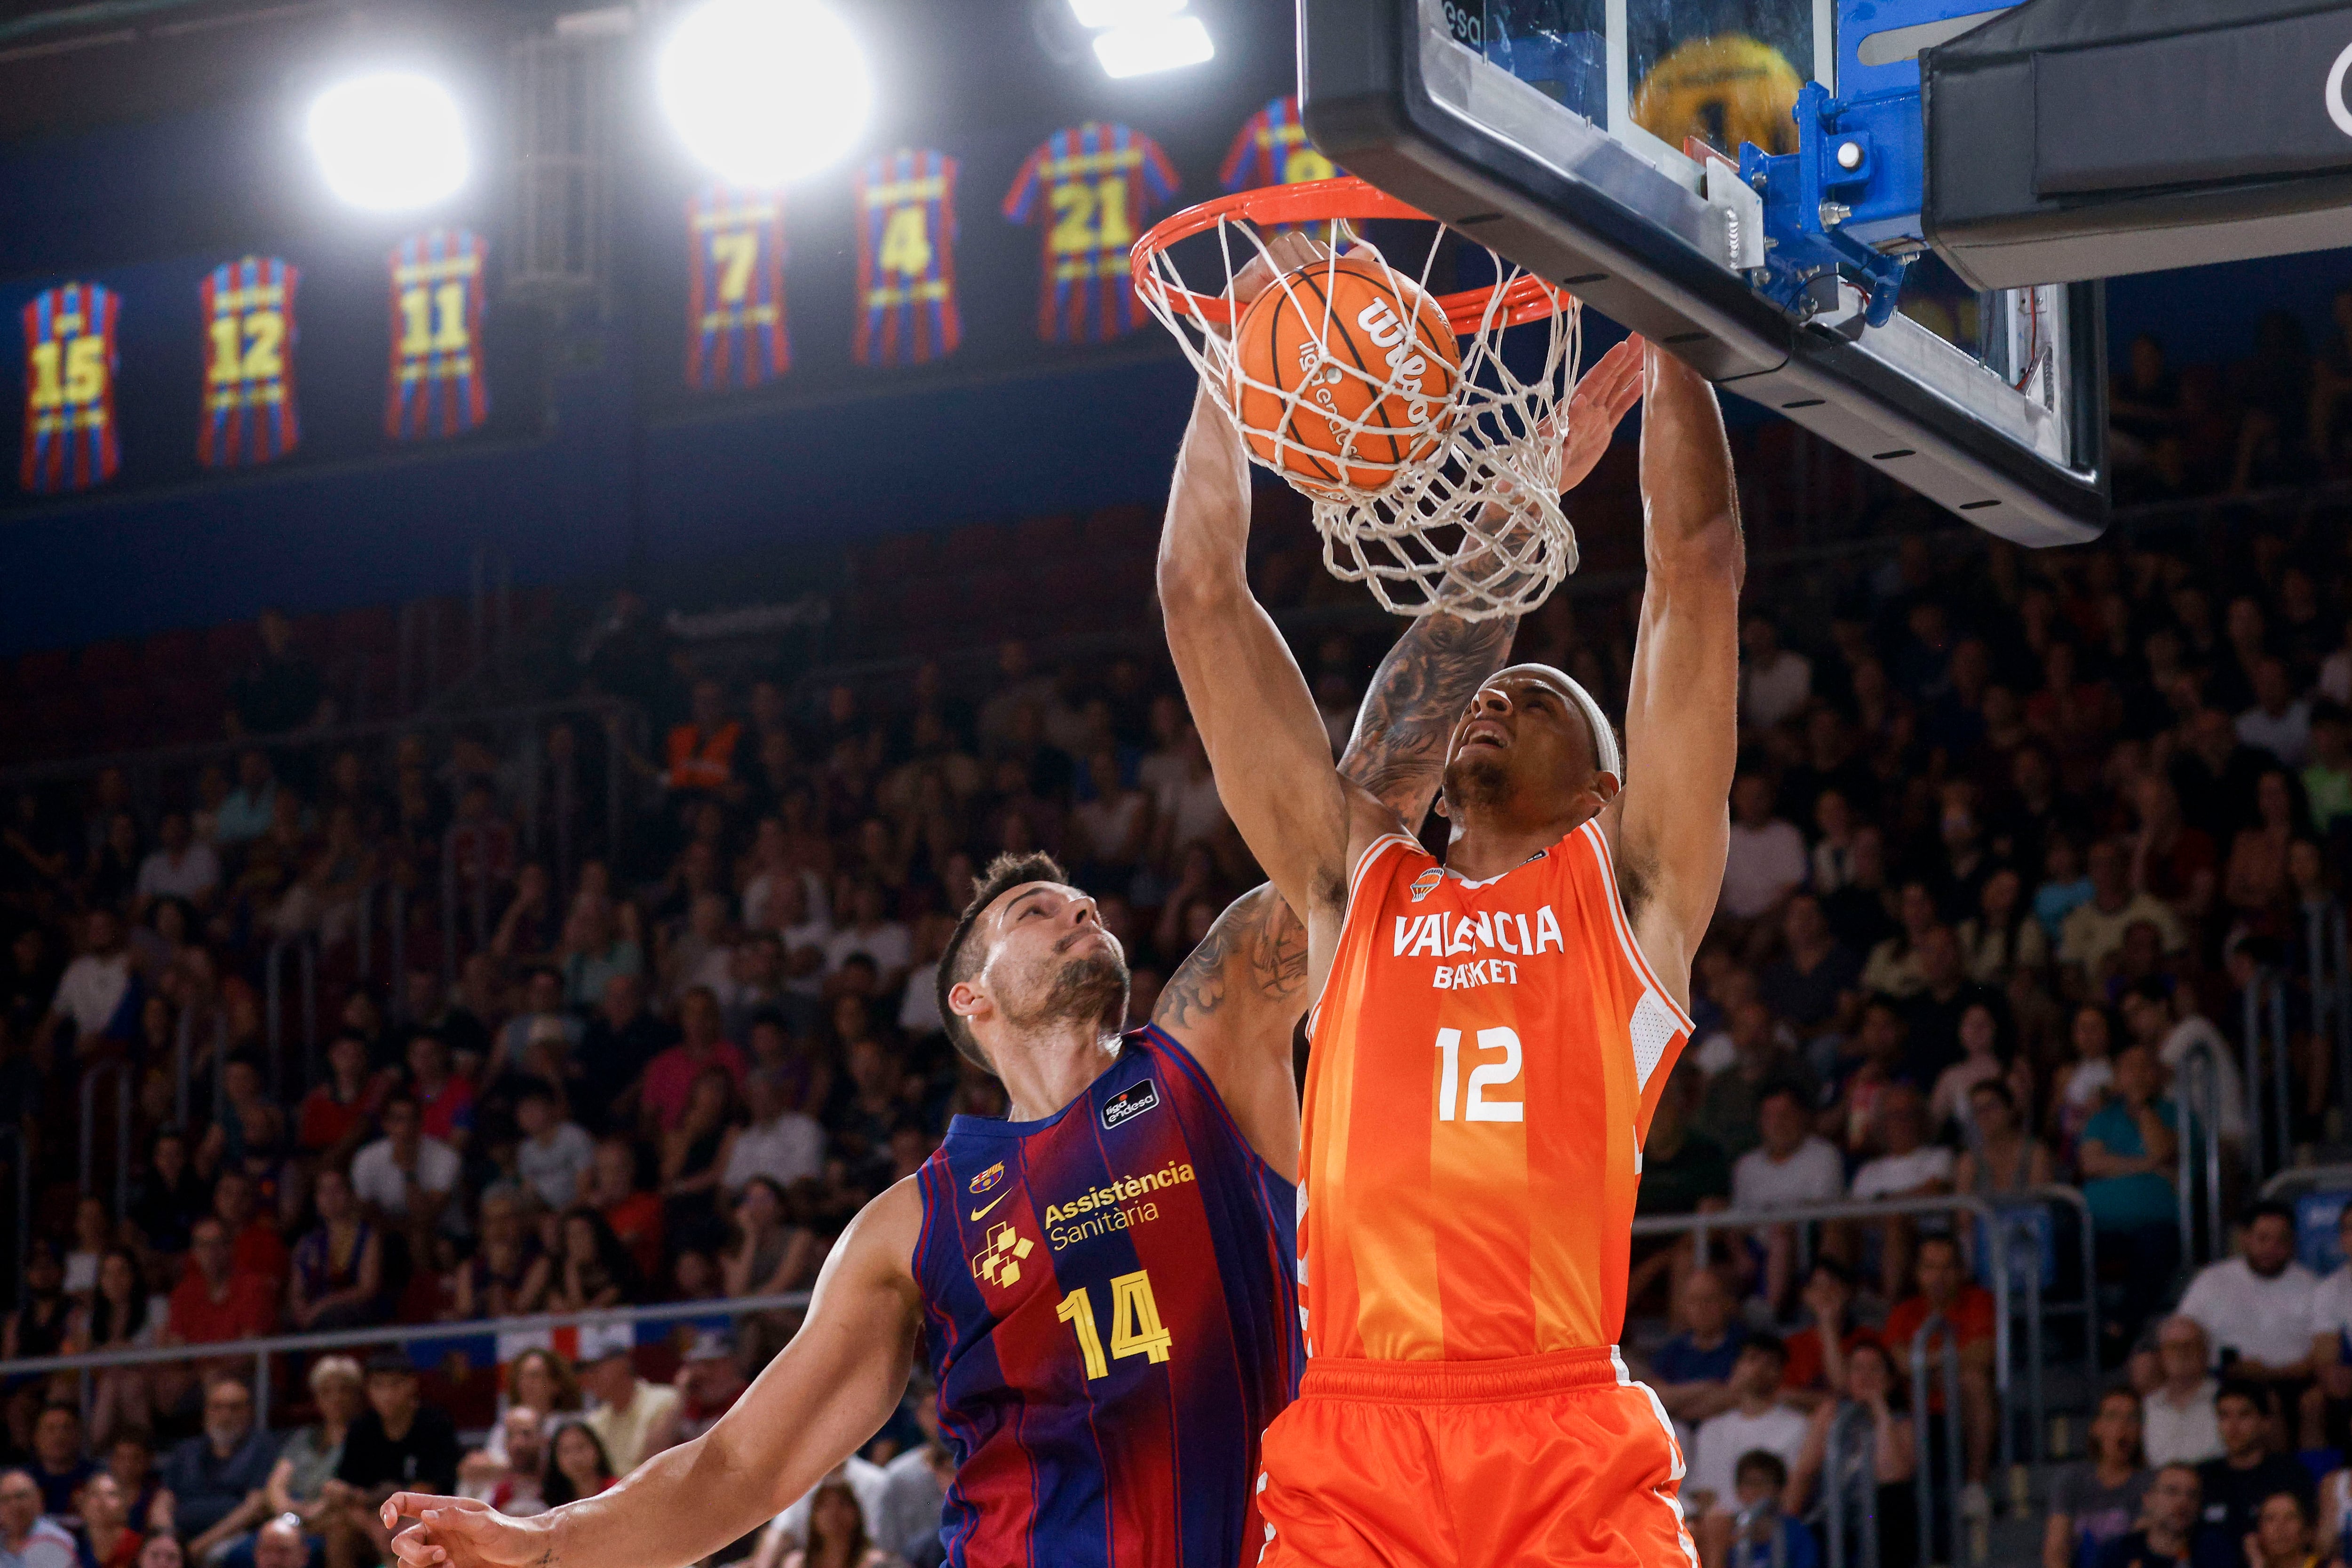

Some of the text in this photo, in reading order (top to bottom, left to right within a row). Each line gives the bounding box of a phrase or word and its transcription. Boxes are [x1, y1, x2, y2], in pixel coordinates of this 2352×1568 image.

[878, 207, 930, 276] 4
[1048, 179, 1131, 253] 21
[712, 234, 758, 301] 7
[210, 311, 284, 383] 12
[400, 284, 470, 354] 11
[30, 335, 105, 408] 15
[1393, 904, 1565, 958] VALENCIA
[1432, 958, 1518, 990] BASKET
[1105, 1100, 1127, 1116] liga
[1108, 1094, 1154, 1123] endesa
[1435, 1026, 1524, 1122] 12
[1045, 1160, 1196, 1230] Assistència
[1050, 1200, 1160, 1251] Sanitària
[1055, 1269, 1173, 1381] 14
